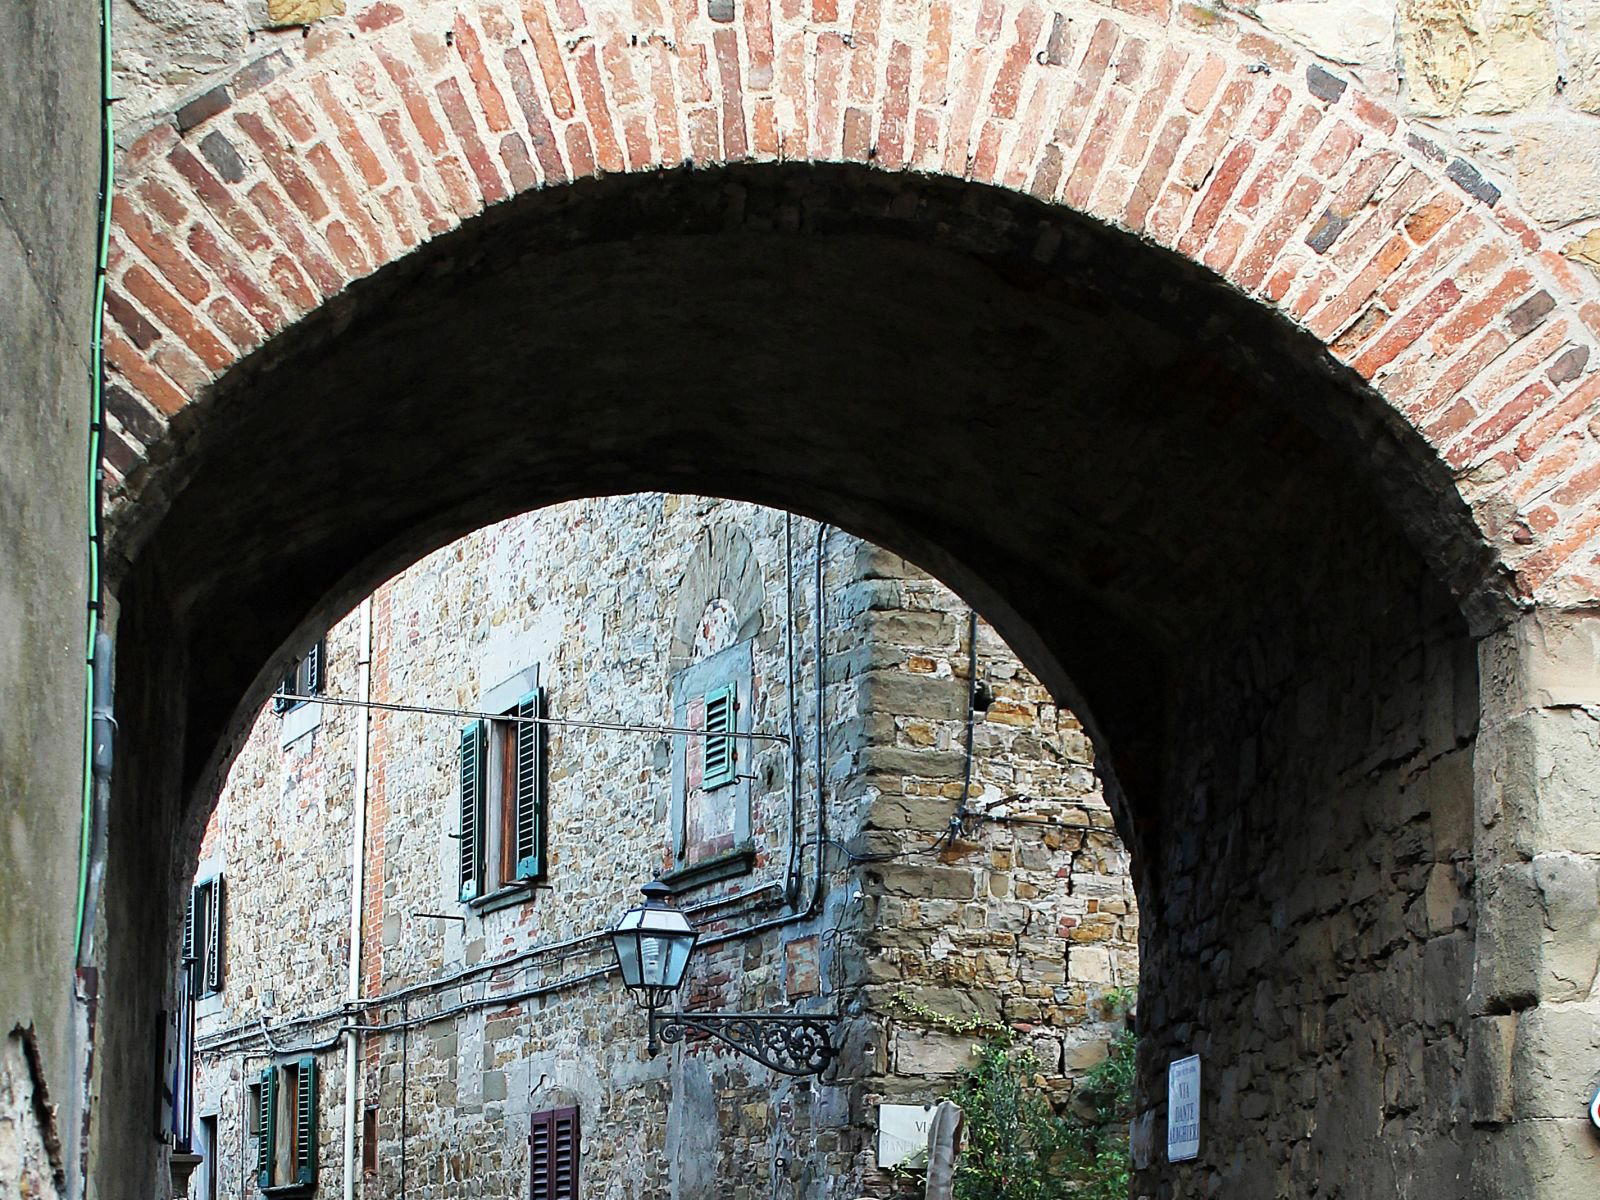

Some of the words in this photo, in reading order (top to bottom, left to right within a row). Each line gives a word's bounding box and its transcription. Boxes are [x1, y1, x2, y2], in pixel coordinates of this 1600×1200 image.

[1178, 1082, 1190, 1099] VIA
[1174, 1102, 1195, 1123] DANTE
[915, 1121, 927, 1133] VI
